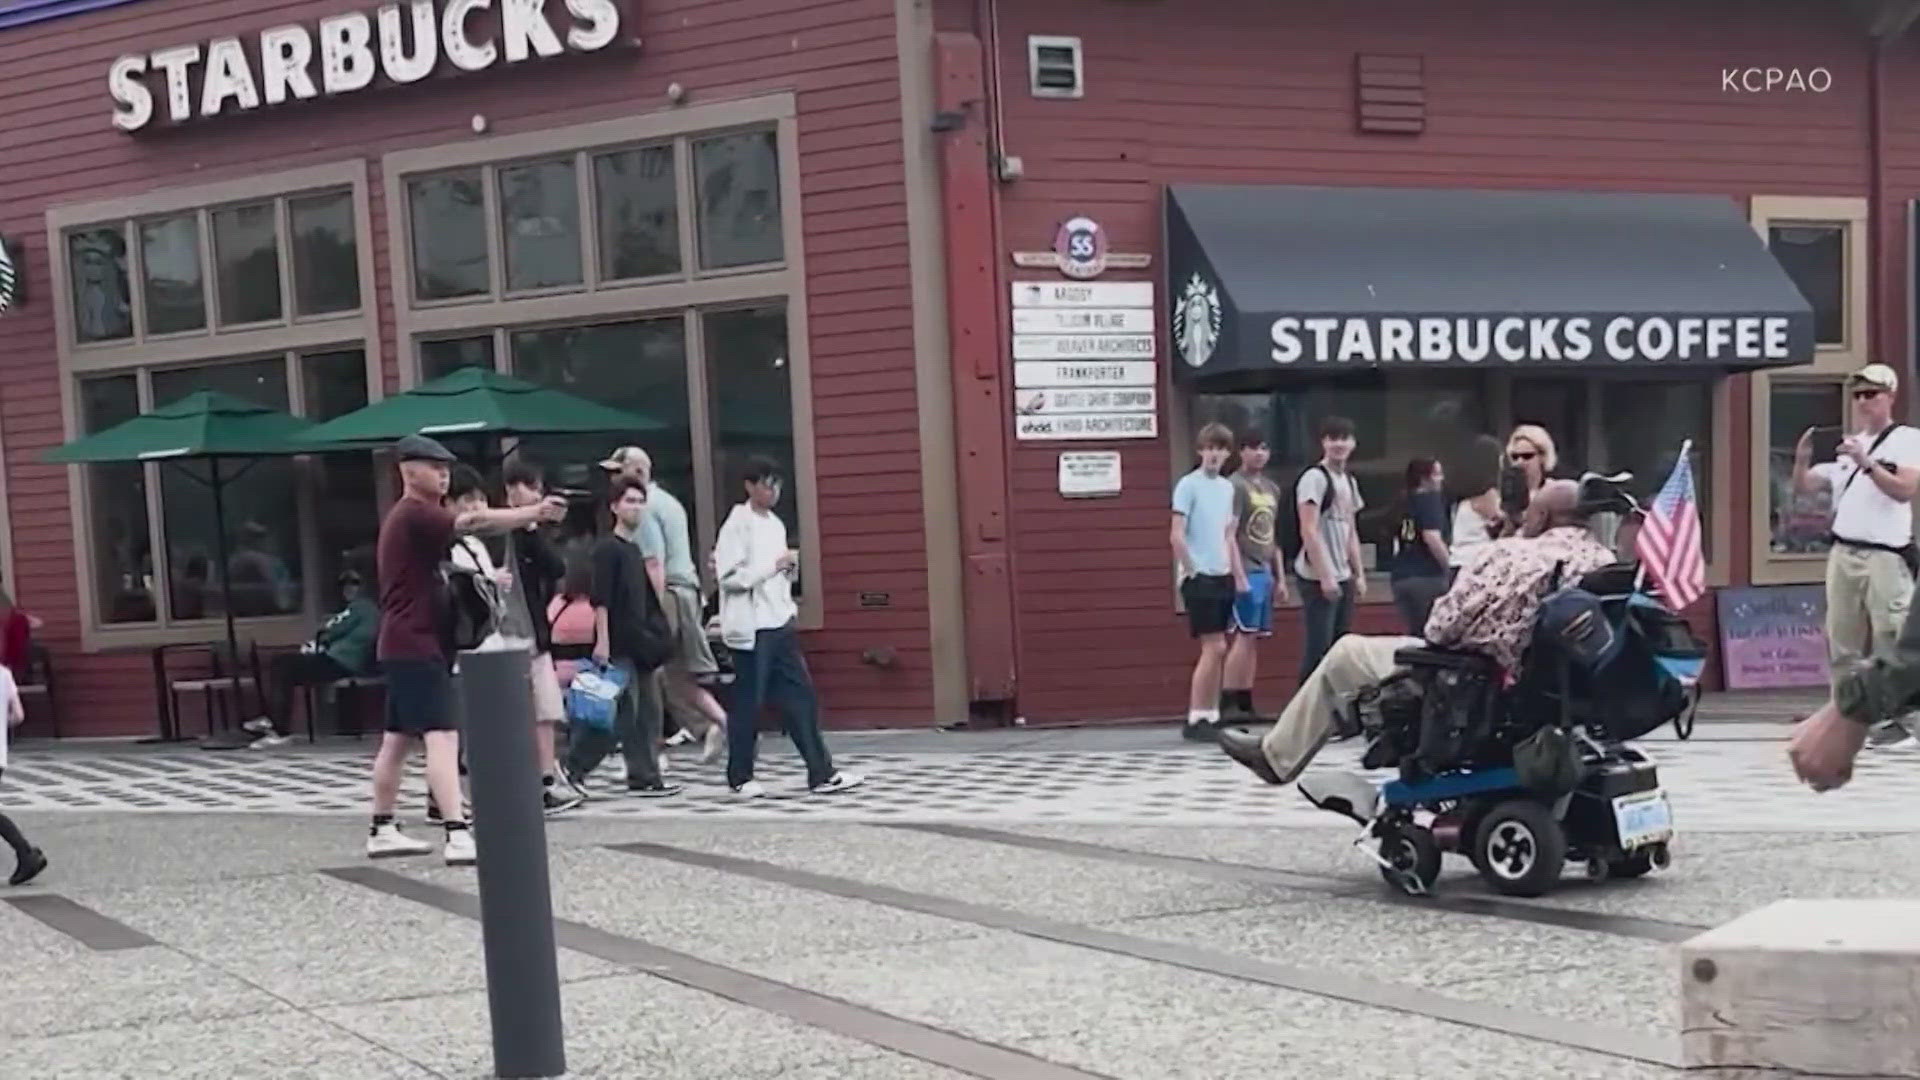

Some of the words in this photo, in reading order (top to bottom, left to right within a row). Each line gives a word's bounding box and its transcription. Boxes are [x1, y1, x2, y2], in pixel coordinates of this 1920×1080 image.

[108, 0, 620, 131] STARBUCKS
[1270, 317, 1593, 363] STARBUCKS
[1603, 317, 1790, 361] COFFEE
